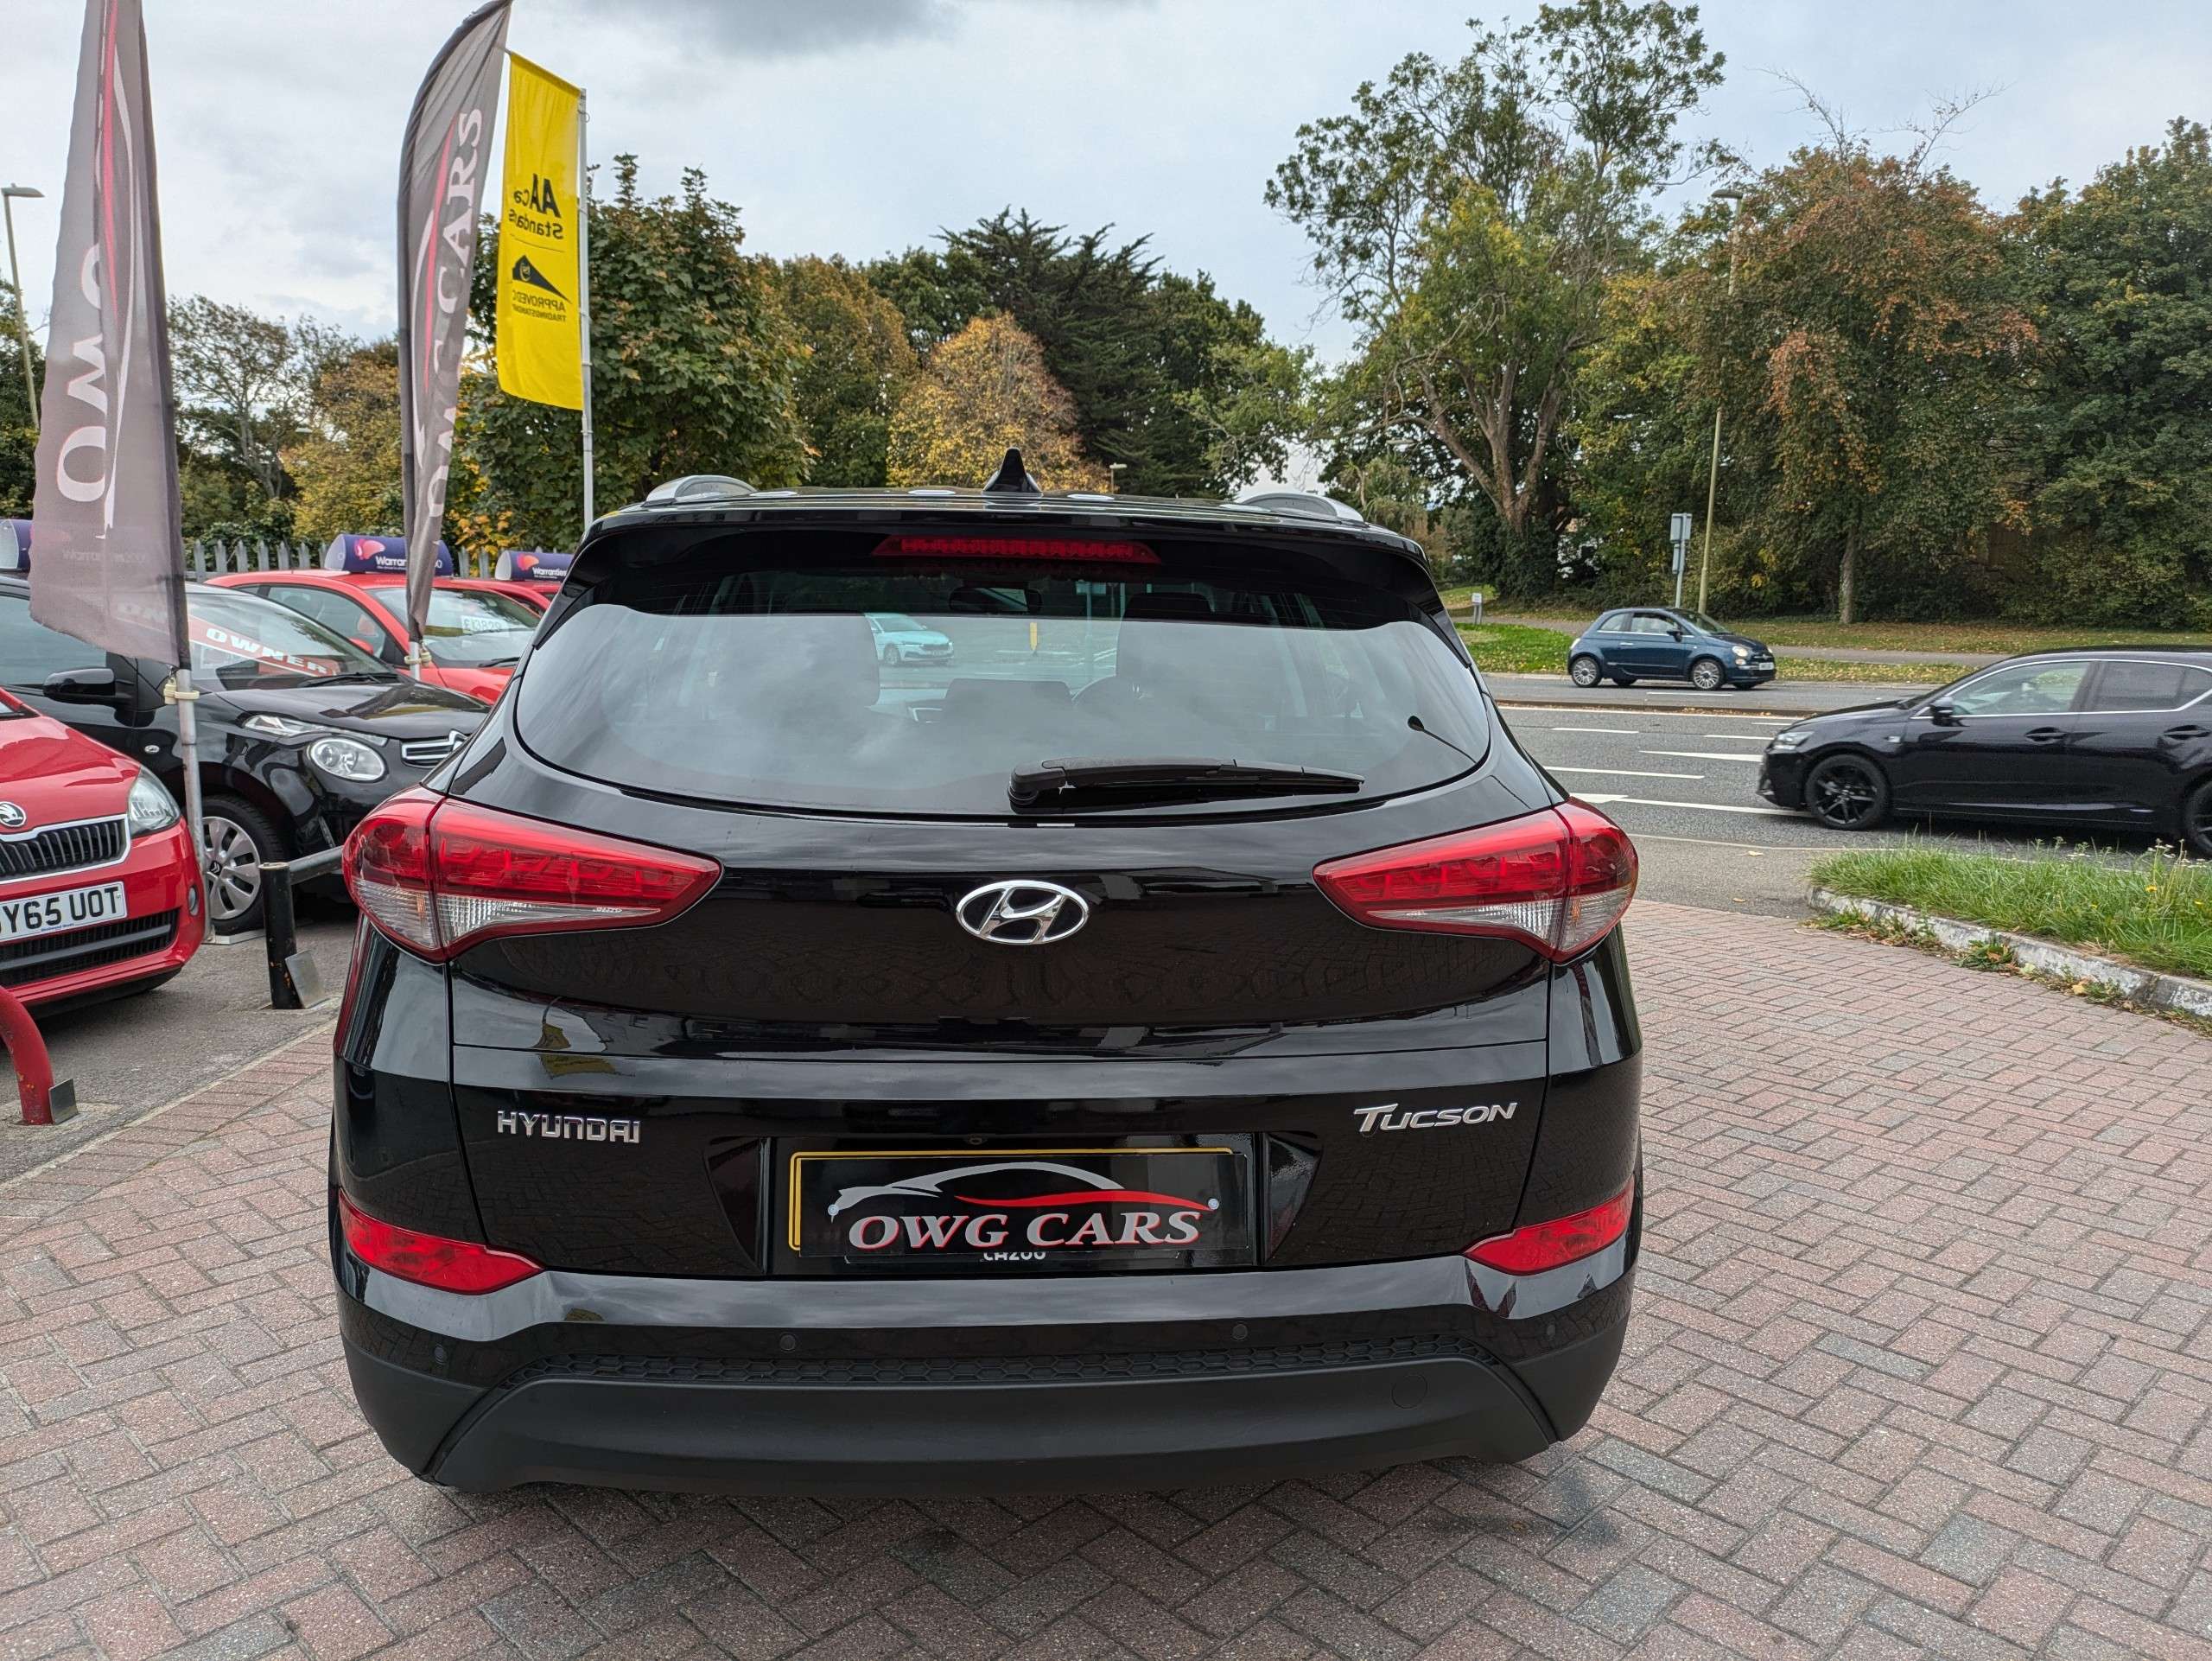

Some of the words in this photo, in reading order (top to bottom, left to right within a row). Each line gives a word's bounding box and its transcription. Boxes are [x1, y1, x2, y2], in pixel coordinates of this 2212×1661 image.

[437, 108, 483, 314] CARS
[206, 627, 327, 674] OWNER
[0, 896, 61, 933] Y65
[69, 886, 118, 921] UOT
[497, 1110, 641, 1143] HYUNDAI
[849, 1213, 1010, 1250] OWG
[1026, 1211, 1202, 1247] CARS
